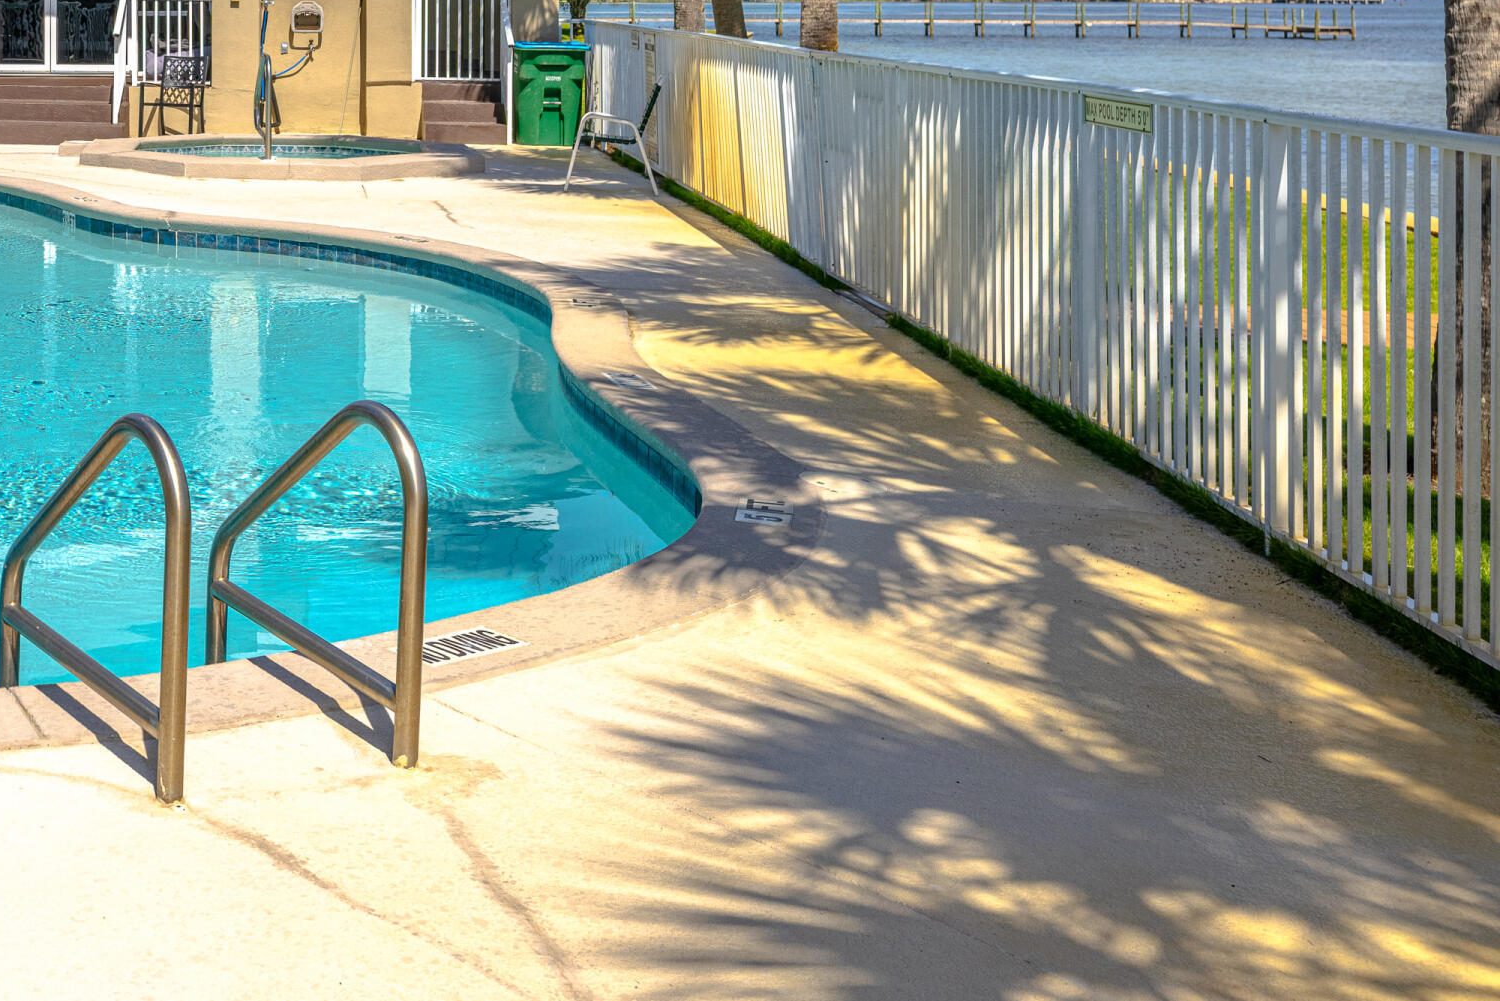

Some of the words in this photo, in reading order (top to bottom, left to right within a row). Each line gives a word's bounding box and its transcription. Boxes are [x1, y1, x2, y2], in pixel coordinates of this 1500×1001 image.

[1099, 103, 1115, 121] POOL
[1115, 106, 1136, 125] DEPTH
[424, 629, 520, 658] DIVING
